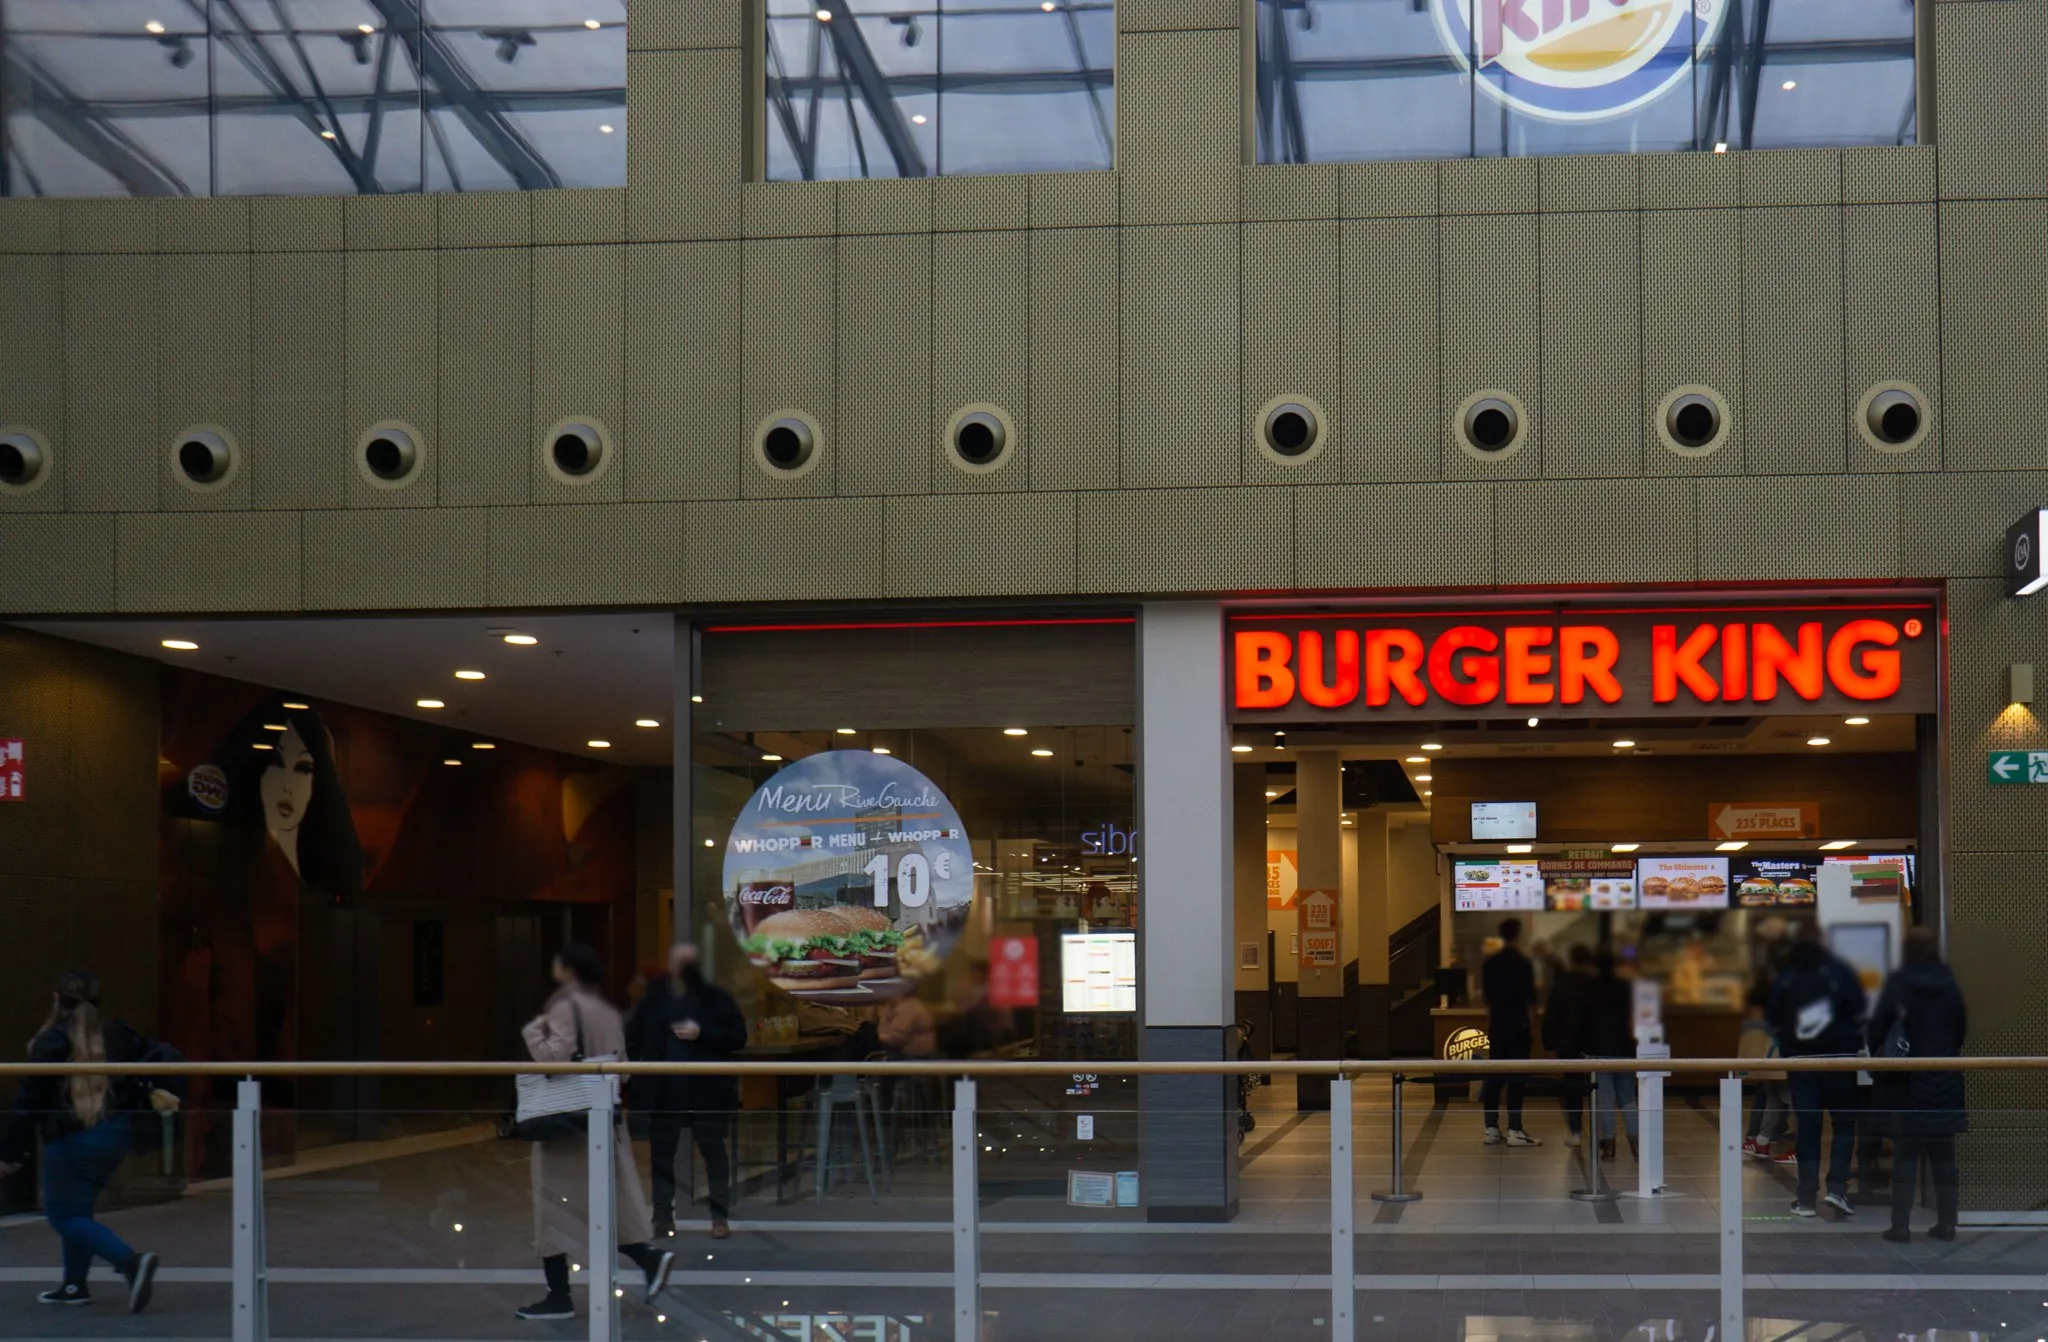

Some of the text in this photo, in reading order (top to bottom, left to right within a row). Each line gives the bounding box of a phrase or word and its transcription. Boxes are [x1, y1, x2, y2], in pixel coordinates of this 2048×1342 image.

[1235, 625, 1623, 708] BURGER
[757, 785, 832, 813] Menu
[1736, 817, 1796, 830] 235 PLACES
[829, 832, 867, 848] MENU
[1568, 850, 1604, 859] RETRAIT
[1541, 860, 1633, 870] BORNES DE COMMANDE
[1758, 861, 1800, 872] Masters
[1310, 904, 1328, 914] 235
